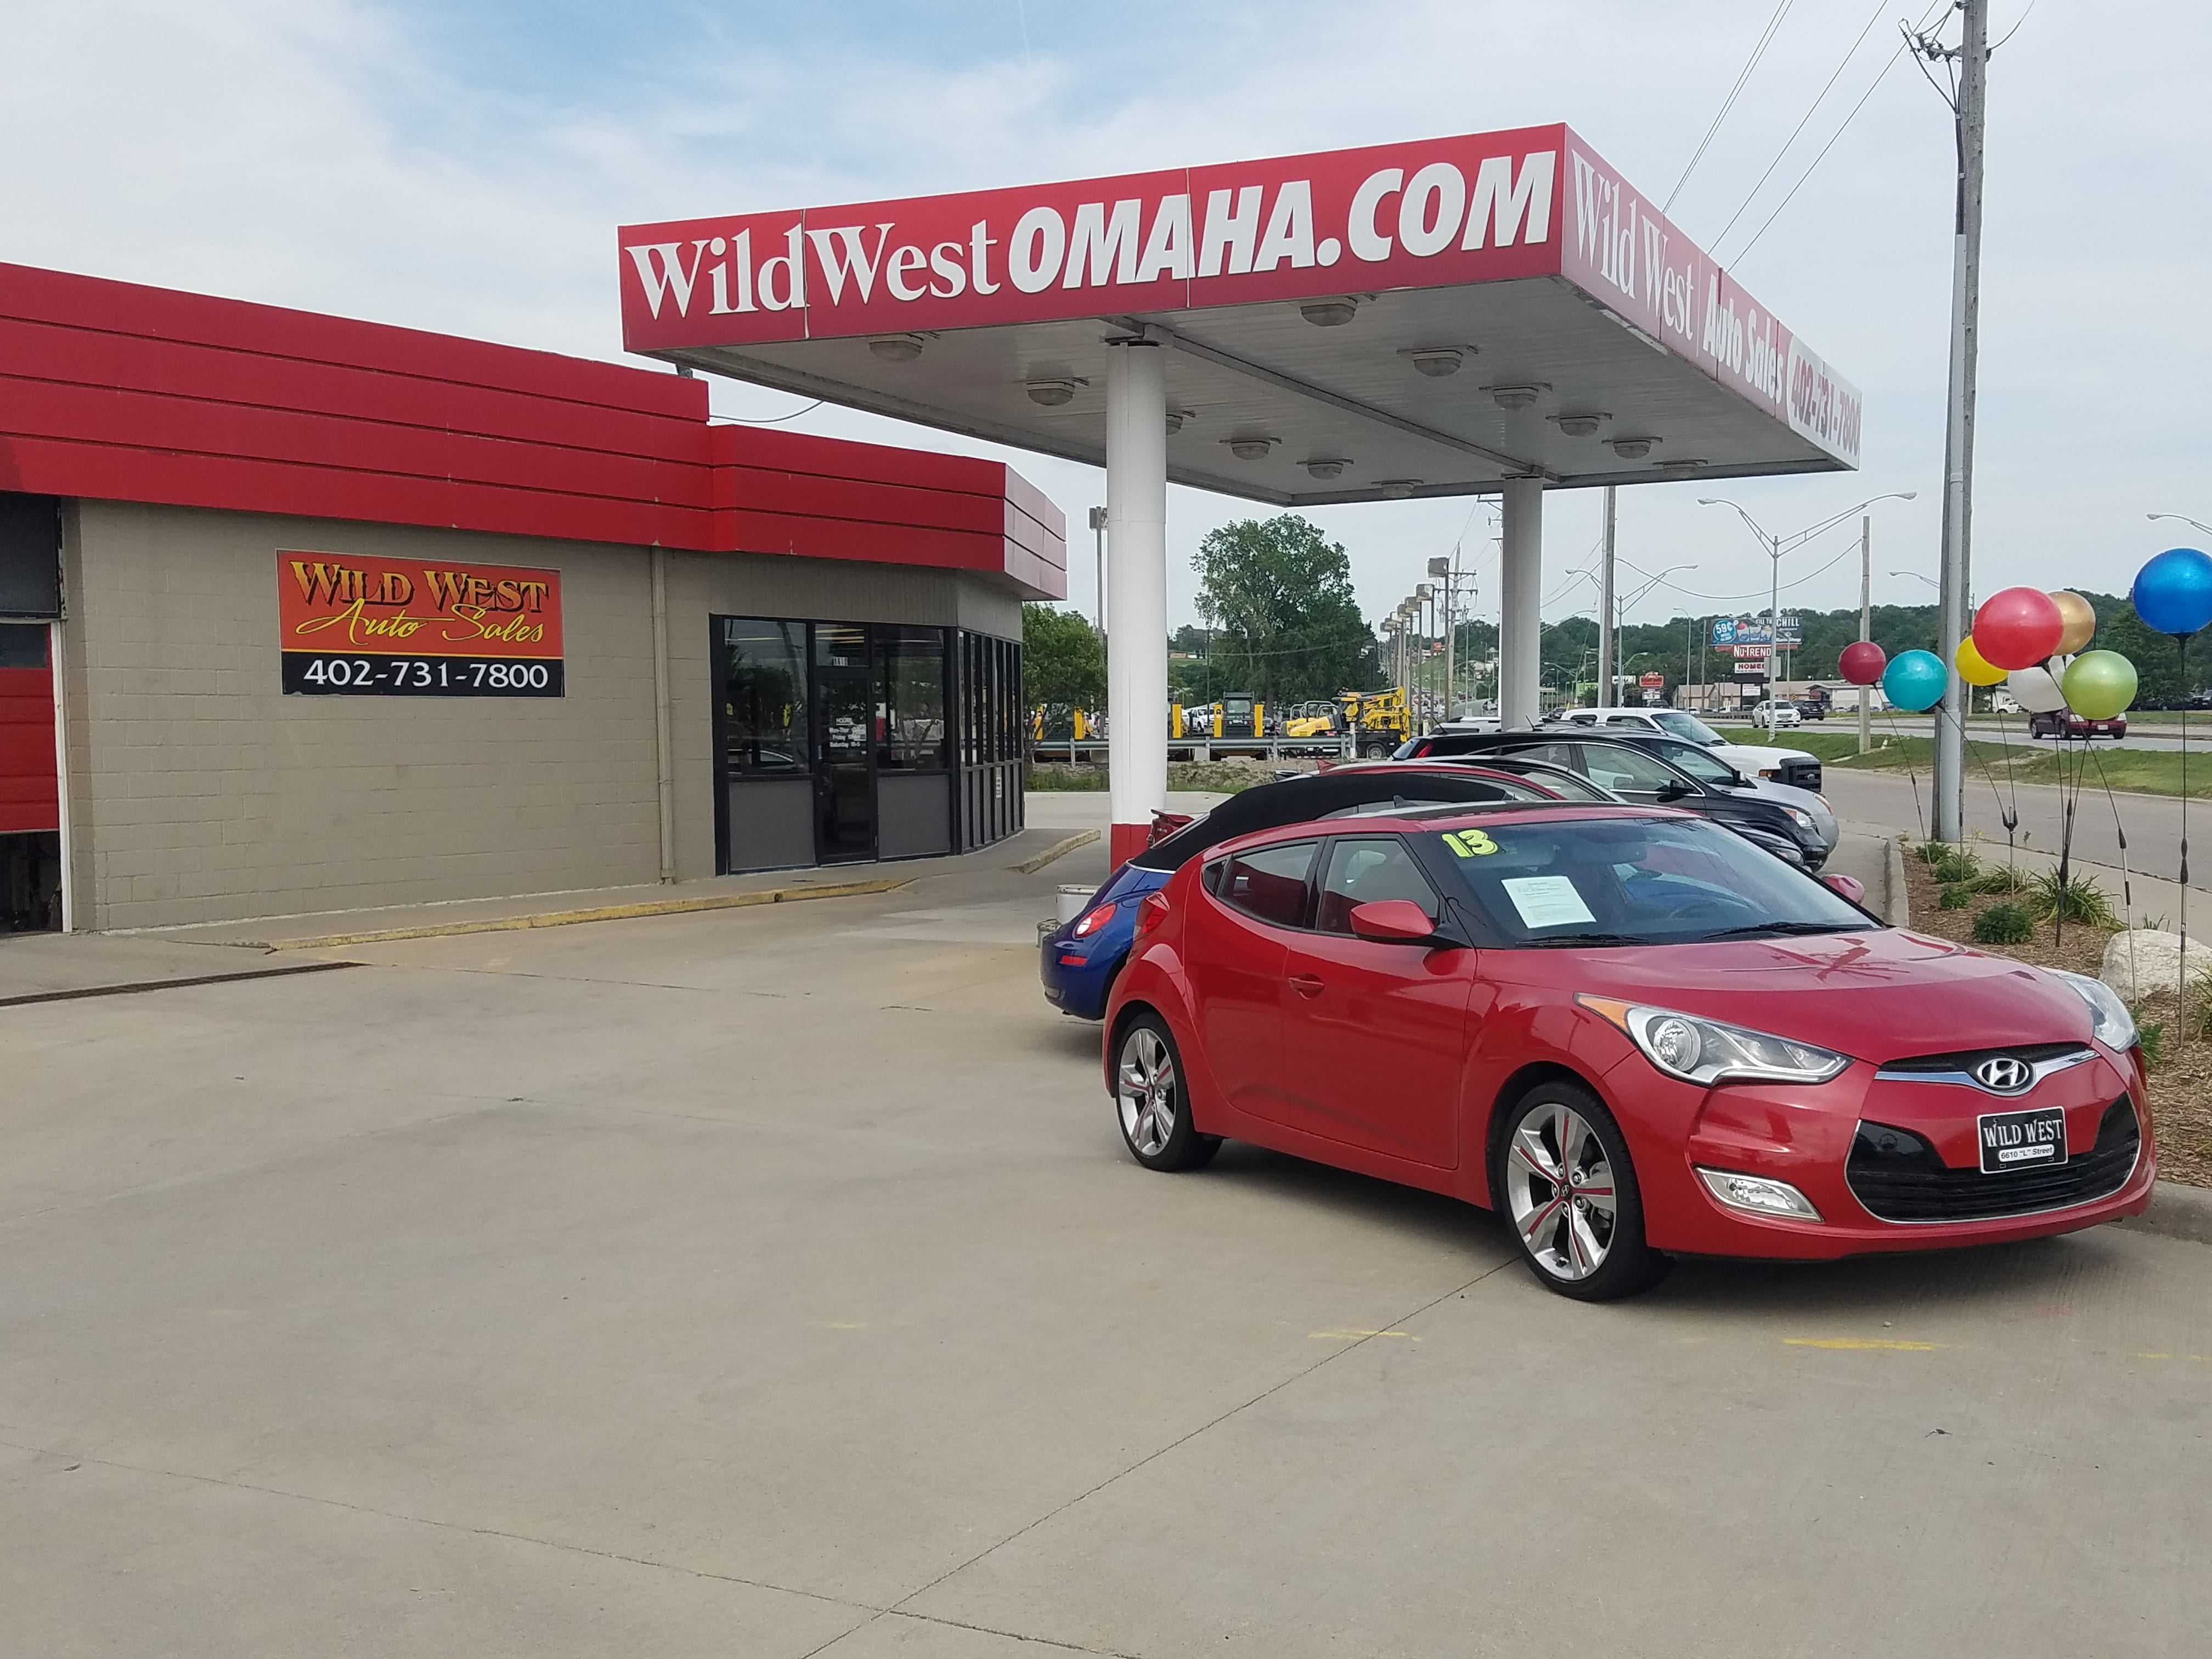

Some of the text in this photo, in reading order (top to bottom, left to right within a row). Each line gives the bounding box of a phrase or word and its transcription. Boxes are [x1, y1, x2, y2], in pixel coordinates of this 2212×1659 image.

[1571, 149, 1784, 404] Wild West Auto Sales
[1791, 354, 1860, 457] 402-731-7800
[290, 561, 549, 613] WILD WEST
[295, 597, 544, 646] Auto Sales
[1776, 618, 1800, 627] CHILL
[303, 659, 549, 689] 402-731-7800
[1441, 829, 1499, 859] 13
[1983, 1118, 2063, 1148] WILD WEST
[2001, 1151, 2018, 1159] 6610
[2032, 1146, 2053, 1155] Street
